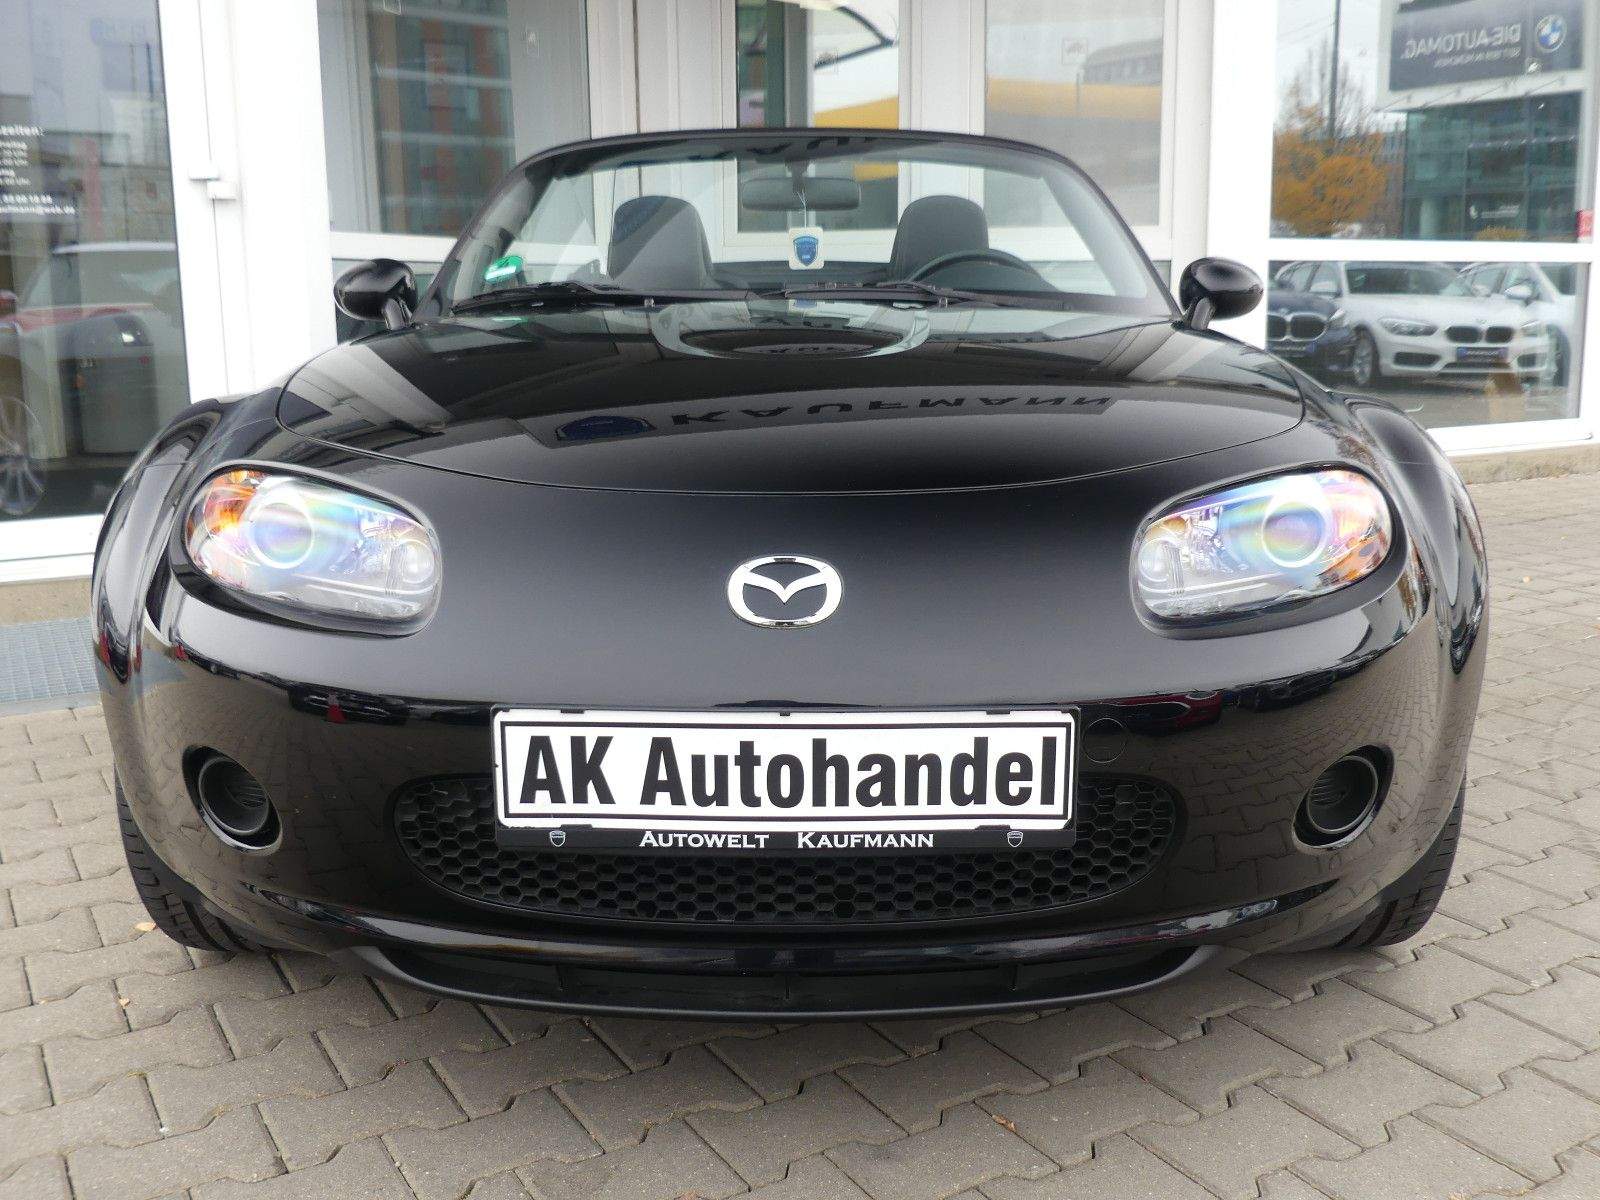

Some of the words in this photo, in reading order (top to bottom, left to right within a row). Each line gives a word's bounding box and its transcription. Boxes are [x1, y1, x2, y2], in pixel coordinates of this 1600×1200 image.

[520, 736, 615, 804] AK
[640, 737, 1056, 808] Autohandel
[639, 831, 769, 848] AUTOWELT
[797, 831, 933, 848] KAUFMANN
